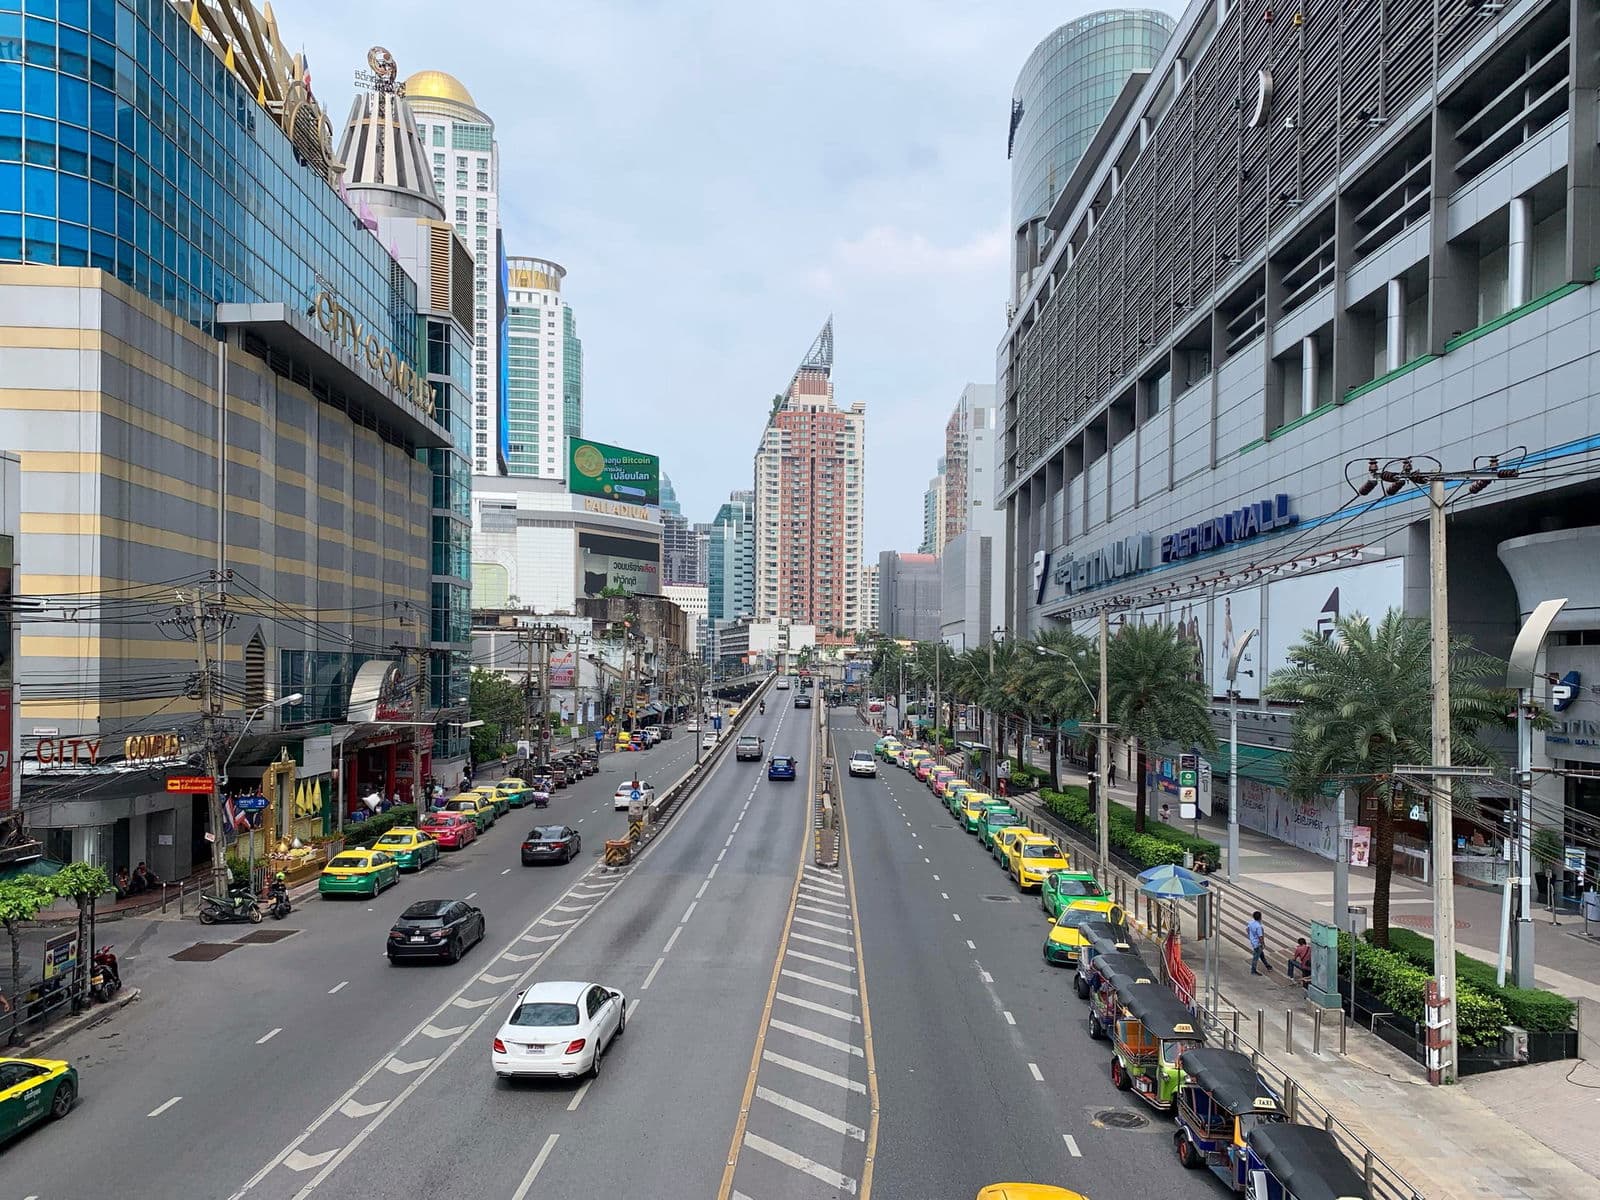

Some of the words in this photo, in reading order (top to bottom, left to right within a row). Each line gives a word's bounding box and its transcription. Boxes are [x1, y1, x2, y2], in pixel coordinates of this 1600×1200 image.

[316, 291, 363, 357] CITY
[622, 456, 651, 464] Bitcoin
[584, 498, 649, 520] PALLADIUM
[1161, 514, 1233, 562] FASHION
[1231, 494, 1299, 540] MALL
[36, 738, 101, 764] CITY
